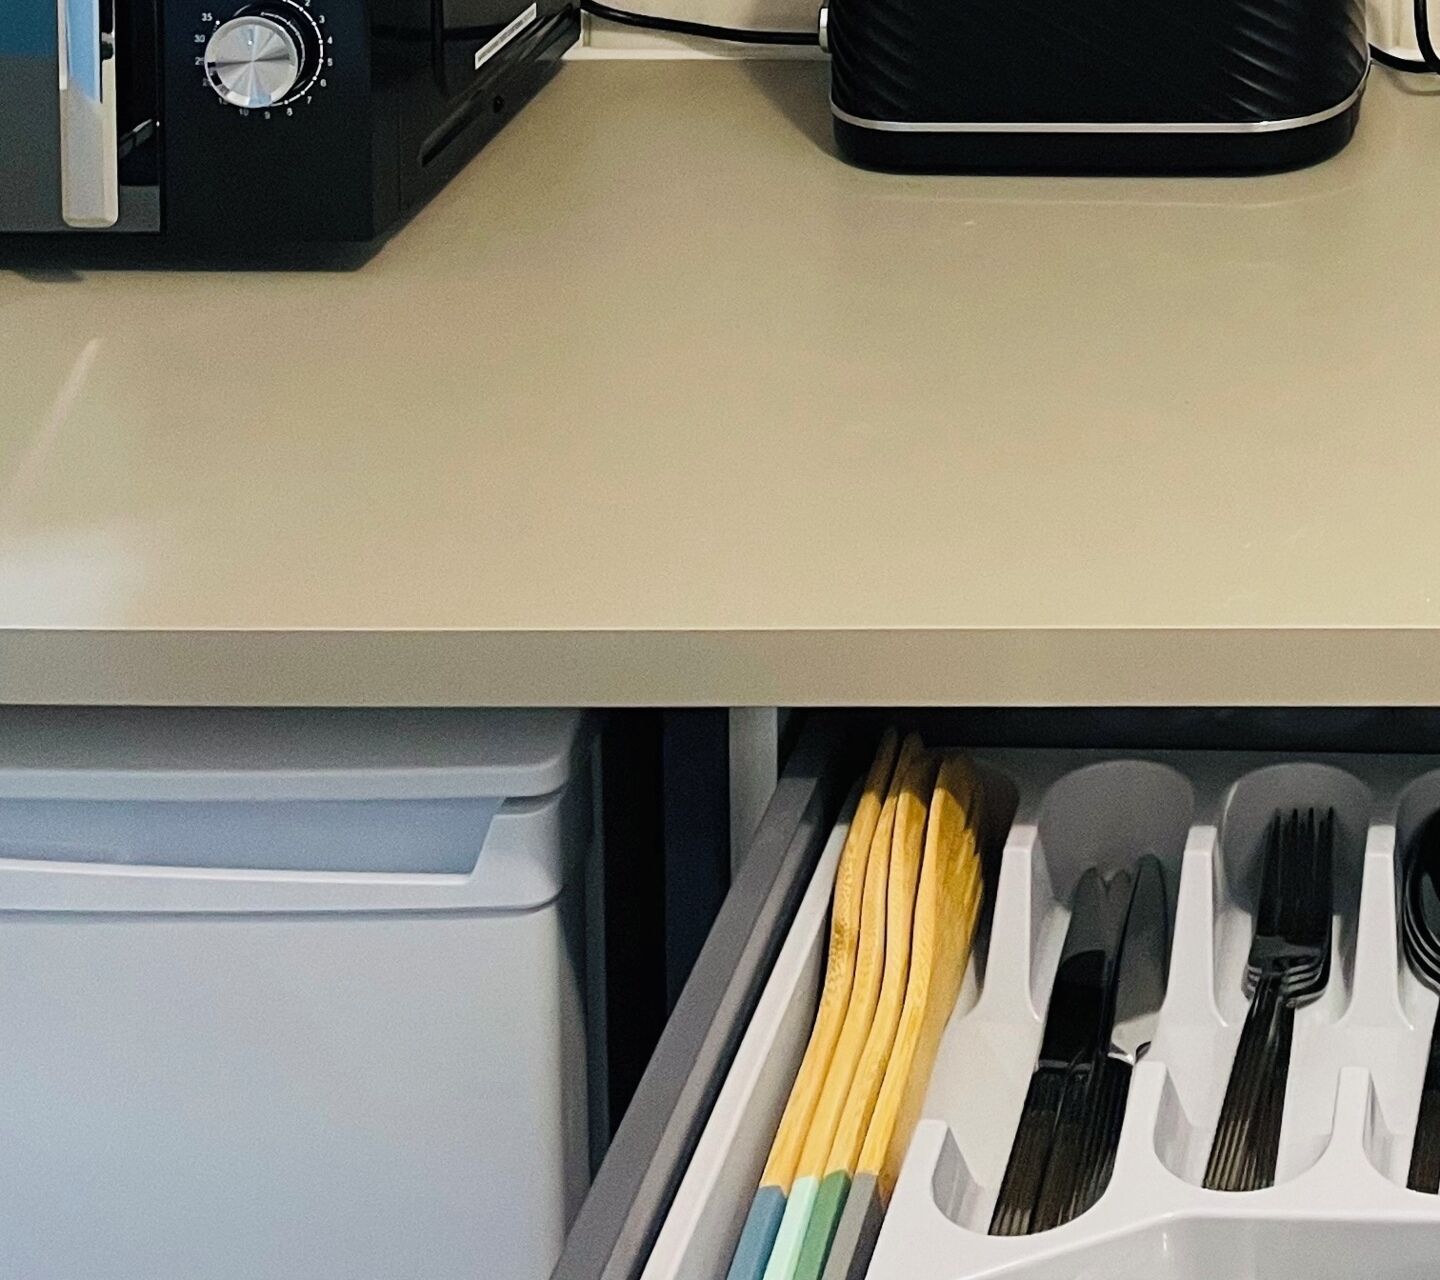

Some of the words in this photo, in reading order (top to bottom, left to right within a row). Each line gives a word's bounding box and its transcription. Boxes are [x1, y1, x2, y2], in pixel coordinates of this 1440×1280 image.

[201, 12, 213, 22] 35
[318, 14, 326, 24] 3
[194, 34, 206, 43] 30
[327, 35, 334, 45] 4
[327, 57, 334, 67] 5
[319, 78, 327, 88] 6
[306, 95, 313, 105] 7
[286, 107, 293, 117] 8
